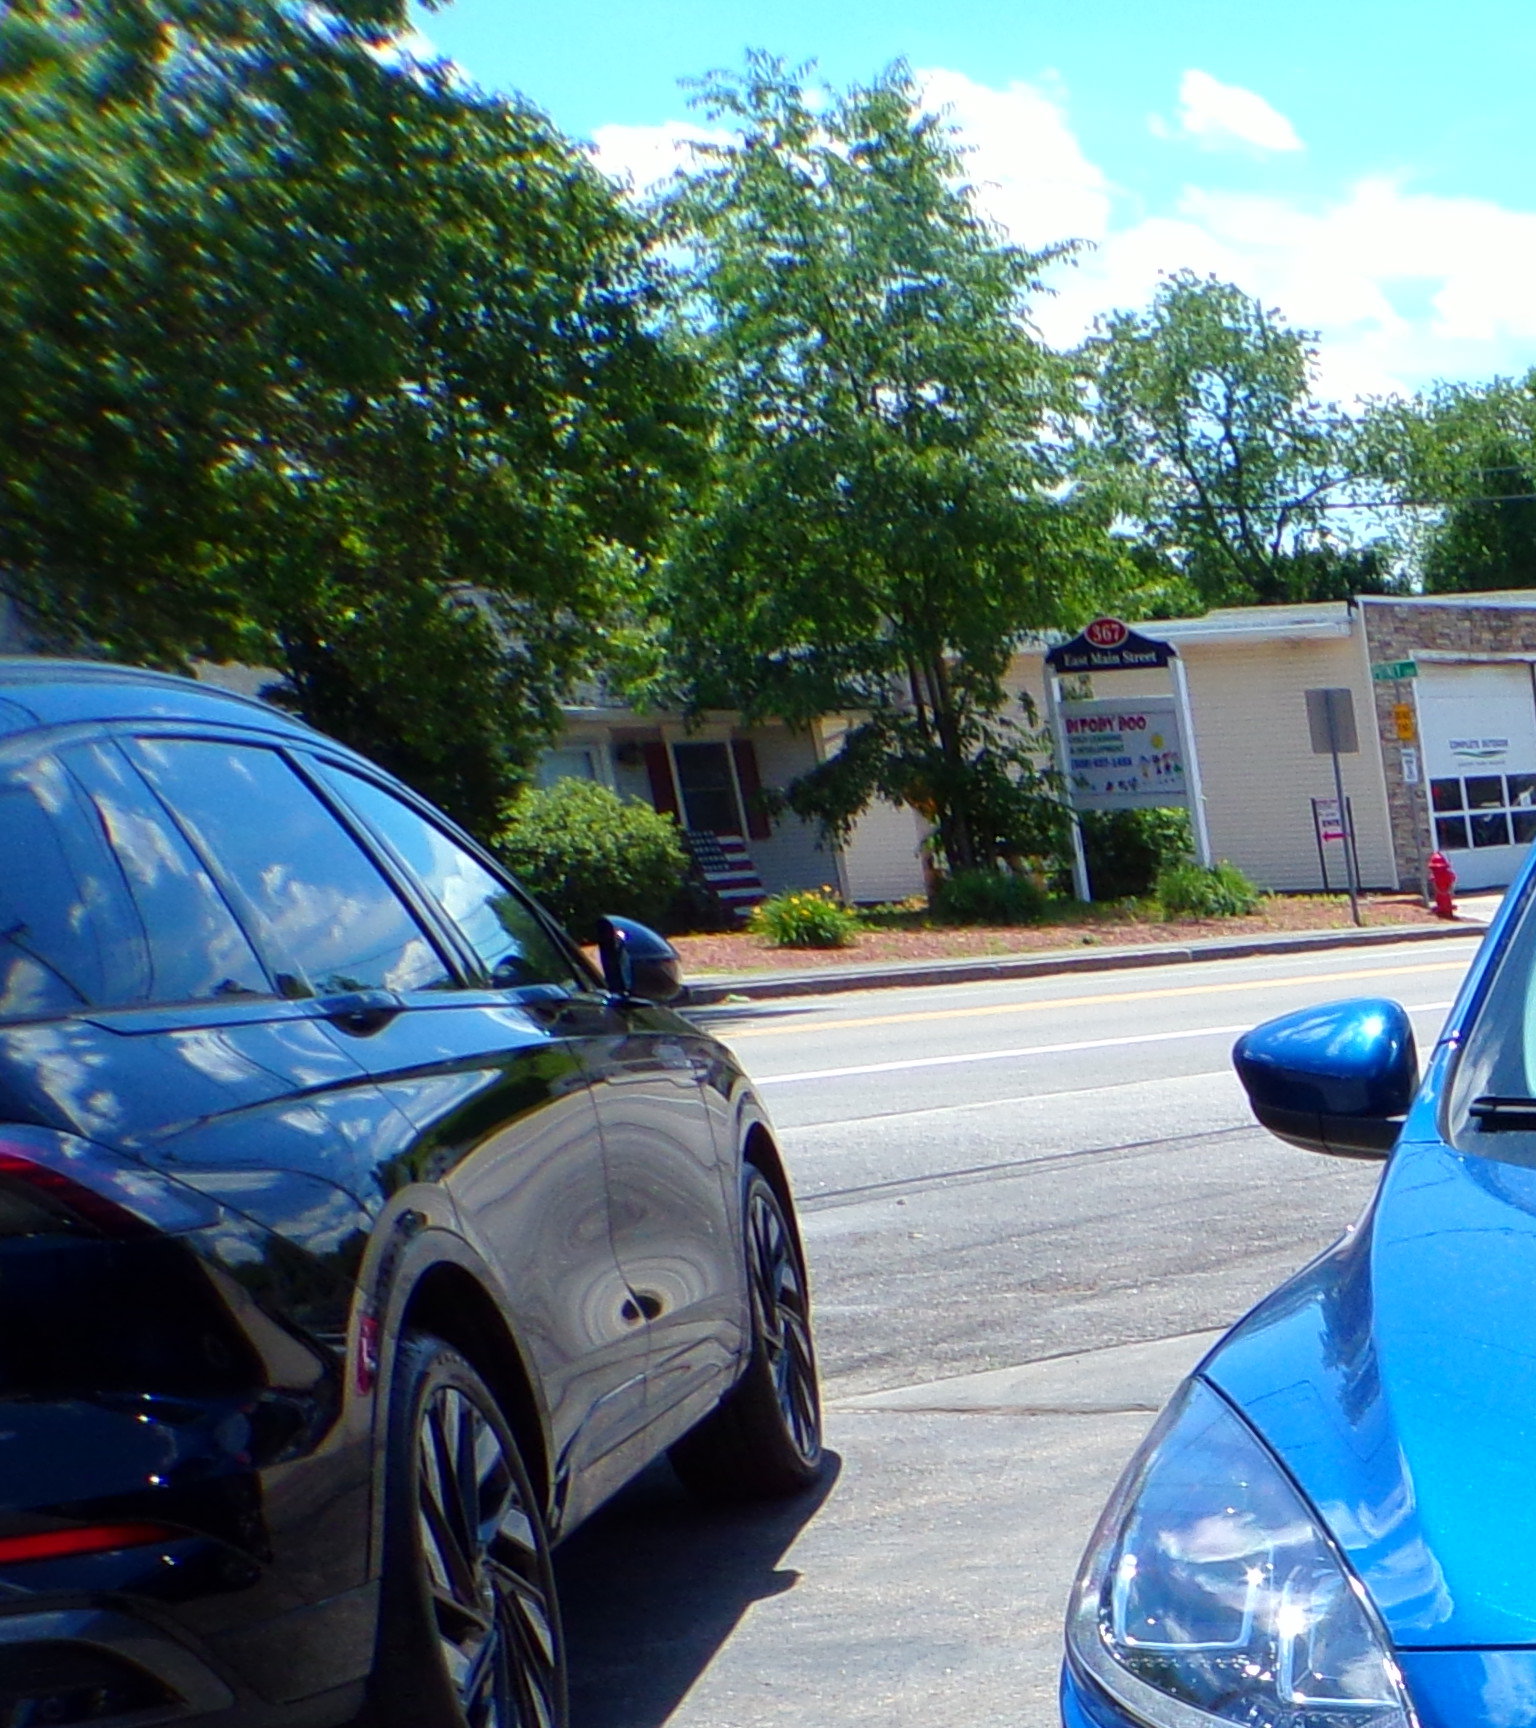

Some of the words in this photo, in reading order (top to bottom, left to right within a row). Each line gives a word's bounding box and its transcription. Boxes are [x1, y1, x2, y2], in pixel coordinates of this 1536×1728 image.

[1091, 623, 1120, 643] 367
[1064, 655, 1088, 667] East
[1090, 652, 1120, 664] Main
[1122, 650, 1157, 663] Street
